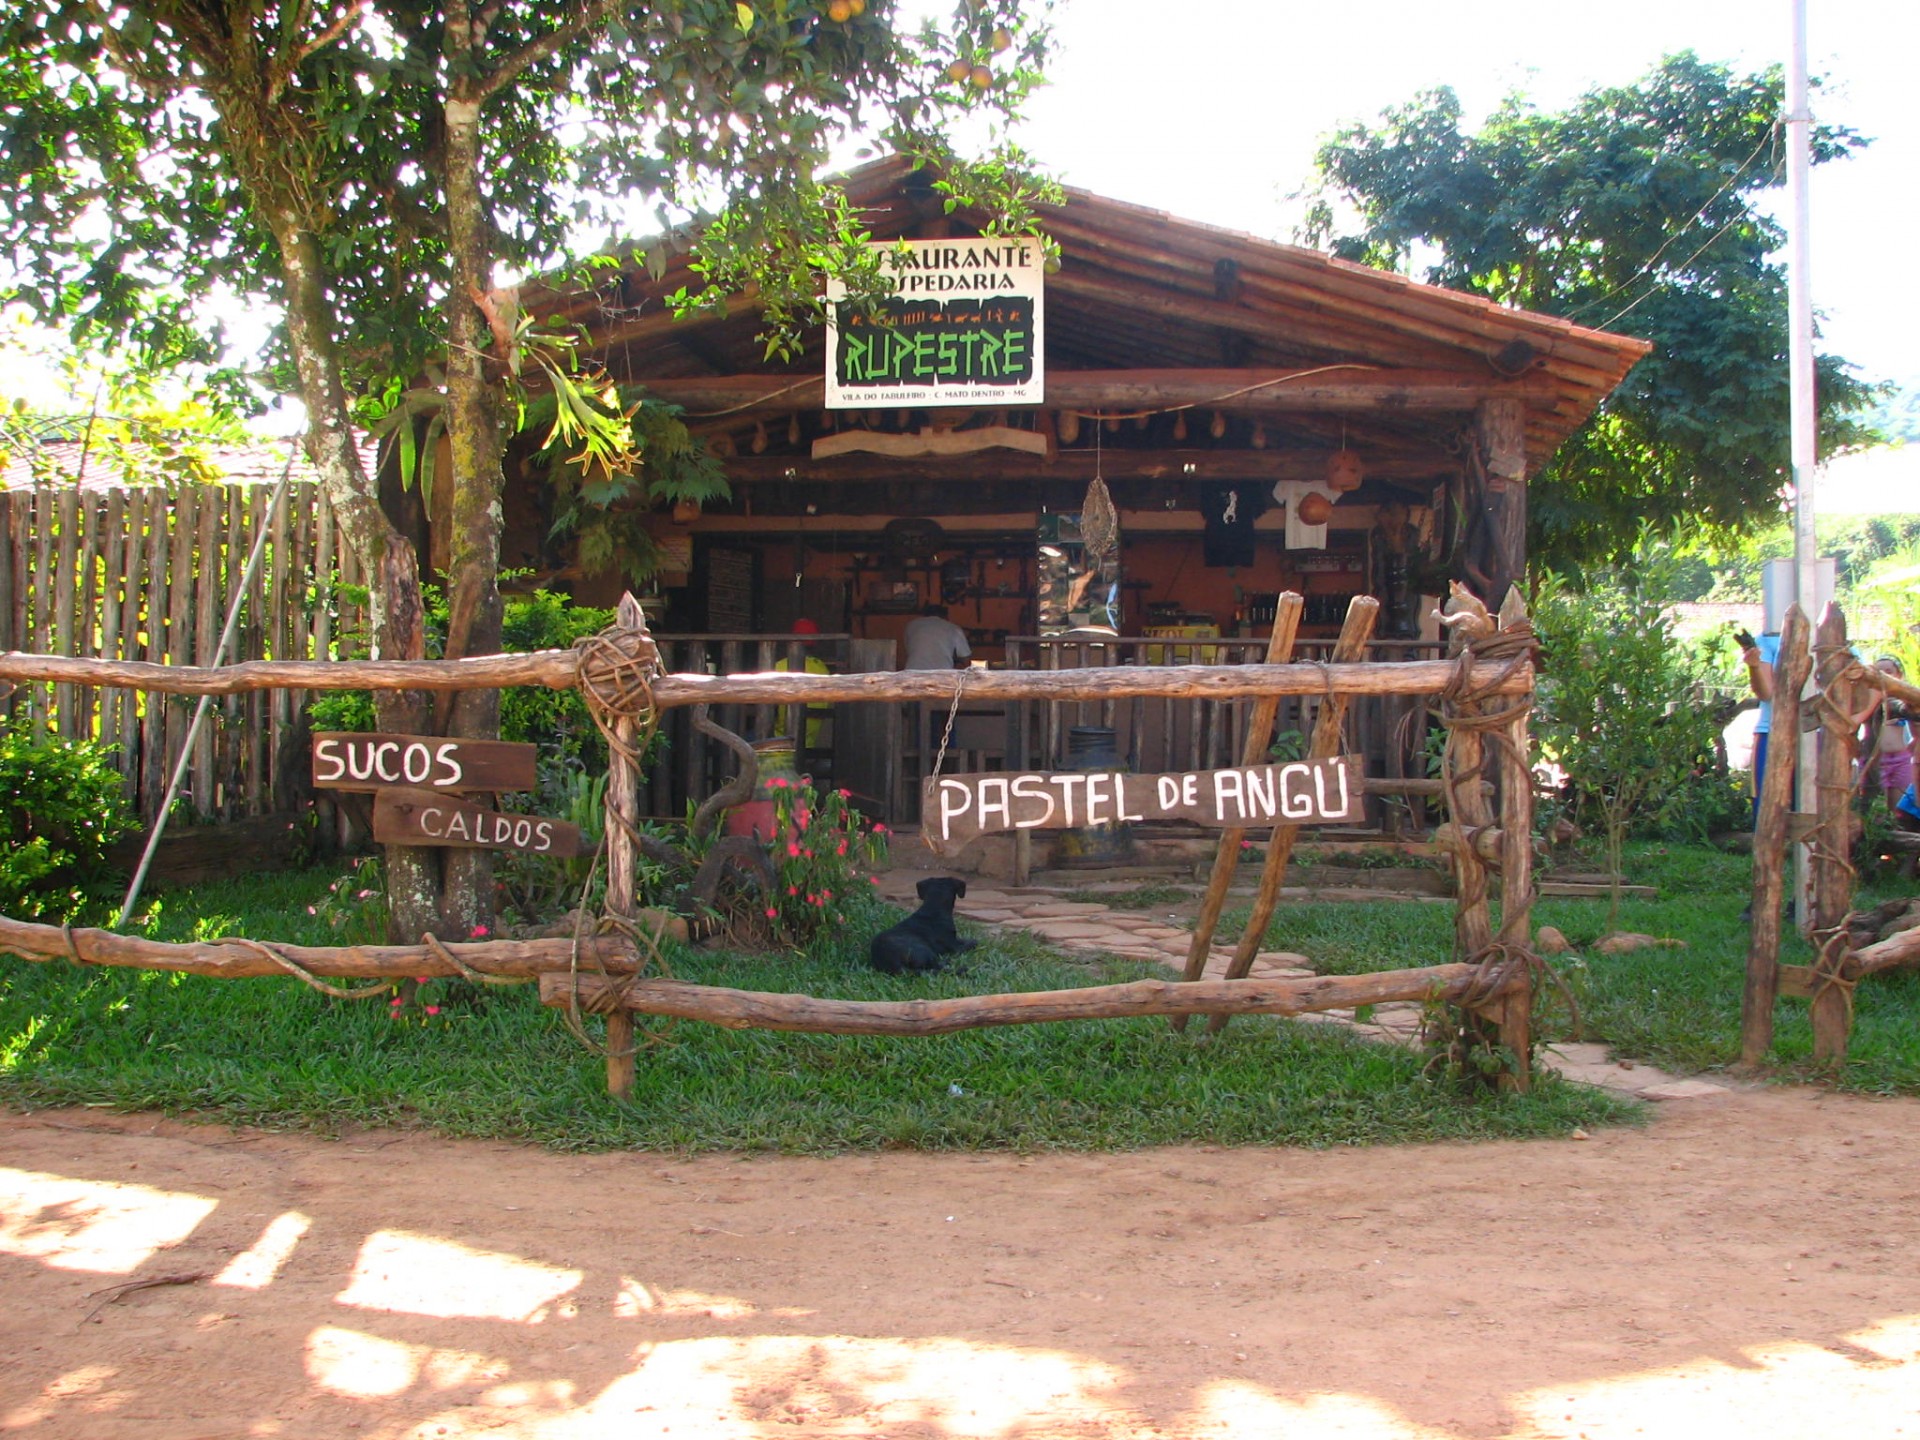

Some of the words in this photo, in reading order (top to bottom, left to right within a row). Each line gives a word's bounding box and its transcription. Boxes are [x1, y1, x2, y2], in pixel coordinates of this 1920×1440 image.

[875, 246, 1033, 271] STAURANTE
[845, 329, 1025, 380] RUPESTRE
[842, 393, 861, 401] VILA
[944, 390, 968, 398] MATO
[971, 389, 1005, 397] DENTRO
[315, 739, 463, 786] SUCOS
[940, 773, 1143, 841] PASTEL
[1157, 774, 1198, 811] DE
[1213, 756, 1349, 821] ANGÚ
[420, 807, 554, 851] CALDOS
